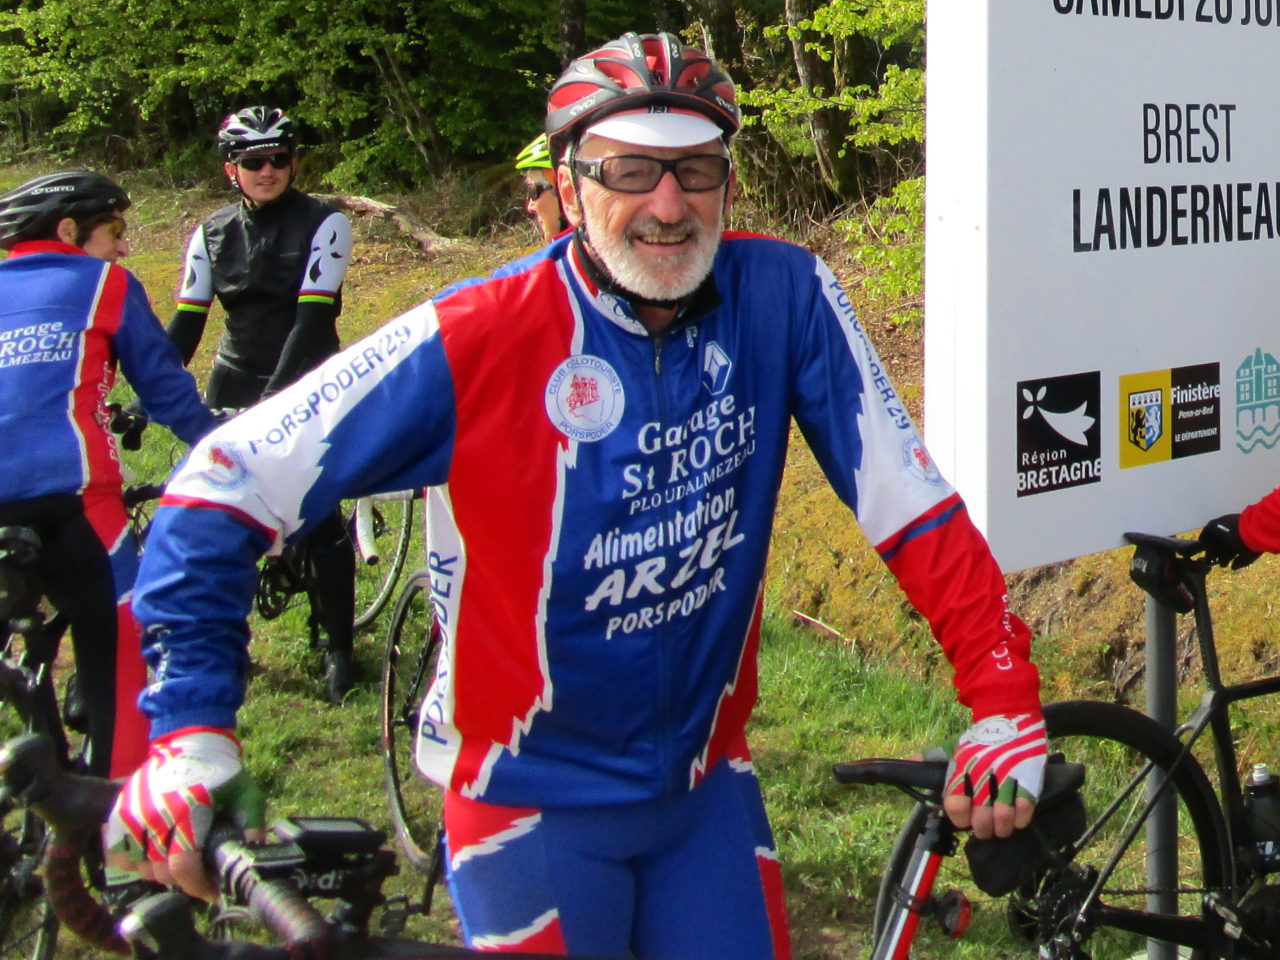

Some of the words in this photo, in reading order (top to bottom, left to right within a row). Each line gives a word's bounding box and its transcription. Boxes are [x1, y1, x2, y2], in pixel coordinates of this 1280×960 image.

[1142, 102, 1237, 164] BREST
[0, 321, 63, 341] arage
[0, 332, 77, 358] ROCH
[0, 350, 73, 368] LMEZEAU
[549, 368, 566, 395] CLUB
[1171, 381, 1221, 405] Finistère
[560, 420, 614, 440] PORSPODER
[637, 394, 736, 454] Garage
[1174, 433, 1181, 442] LE
[1181, 427, 1218, 441] DÉPARTEMENT
[621, 464, 655, 499] St
[668, 406, 756, 483] ROCH
[1022, 449, 1067, 466] Région
[629, 440, 756, 515] PLOUDALMEZEAU
[1017, 458, 1102, 491] BRETAGNE
[584, 487, 735, 570] Alimentation
[584, 510, 745, 611] ARZEL
